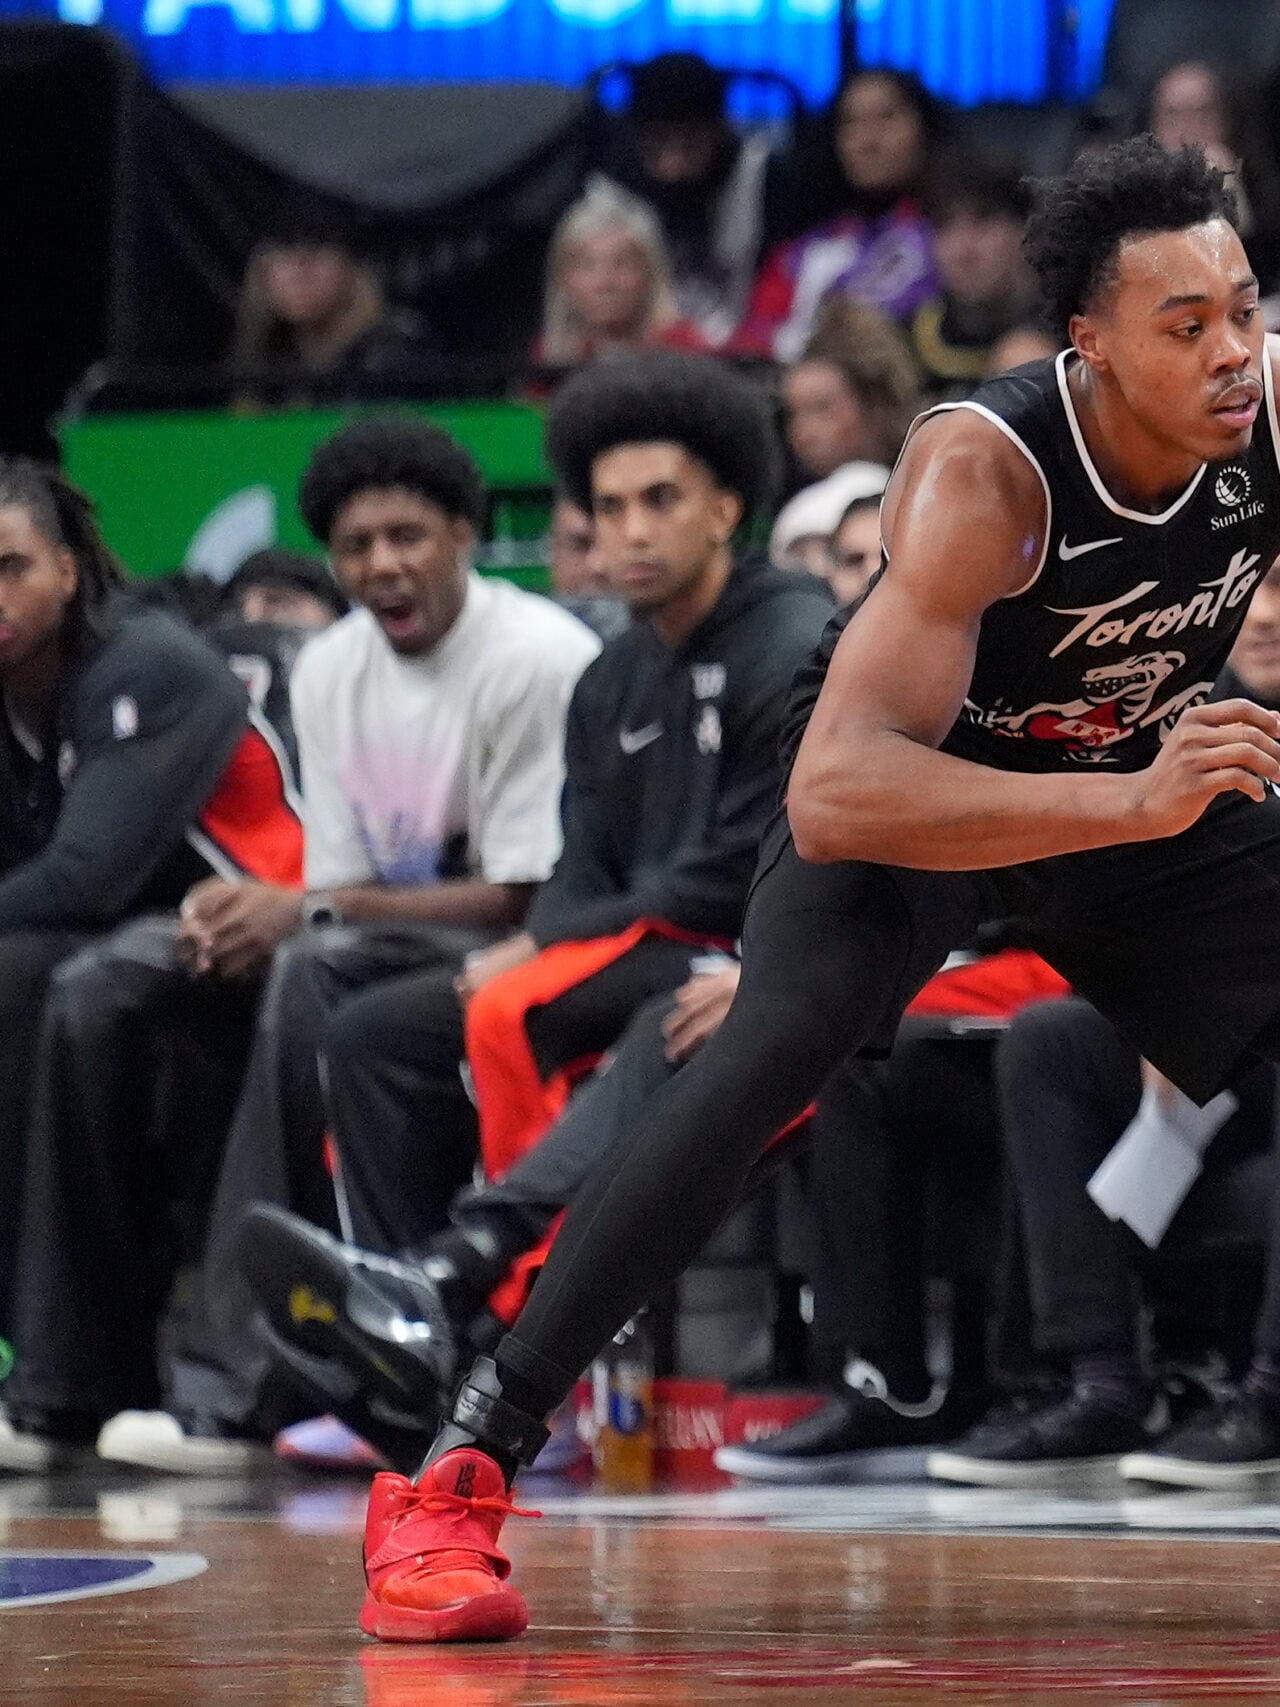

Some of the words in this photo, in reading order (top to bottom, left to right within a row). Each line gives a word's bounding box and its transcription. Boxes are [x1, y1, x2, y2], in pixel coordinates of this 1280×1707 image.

[1210, 513, 1238, 531] Sun
[1240, 500, 1265, 521] Life
[1044, 546, 1261, 658] Toronto
